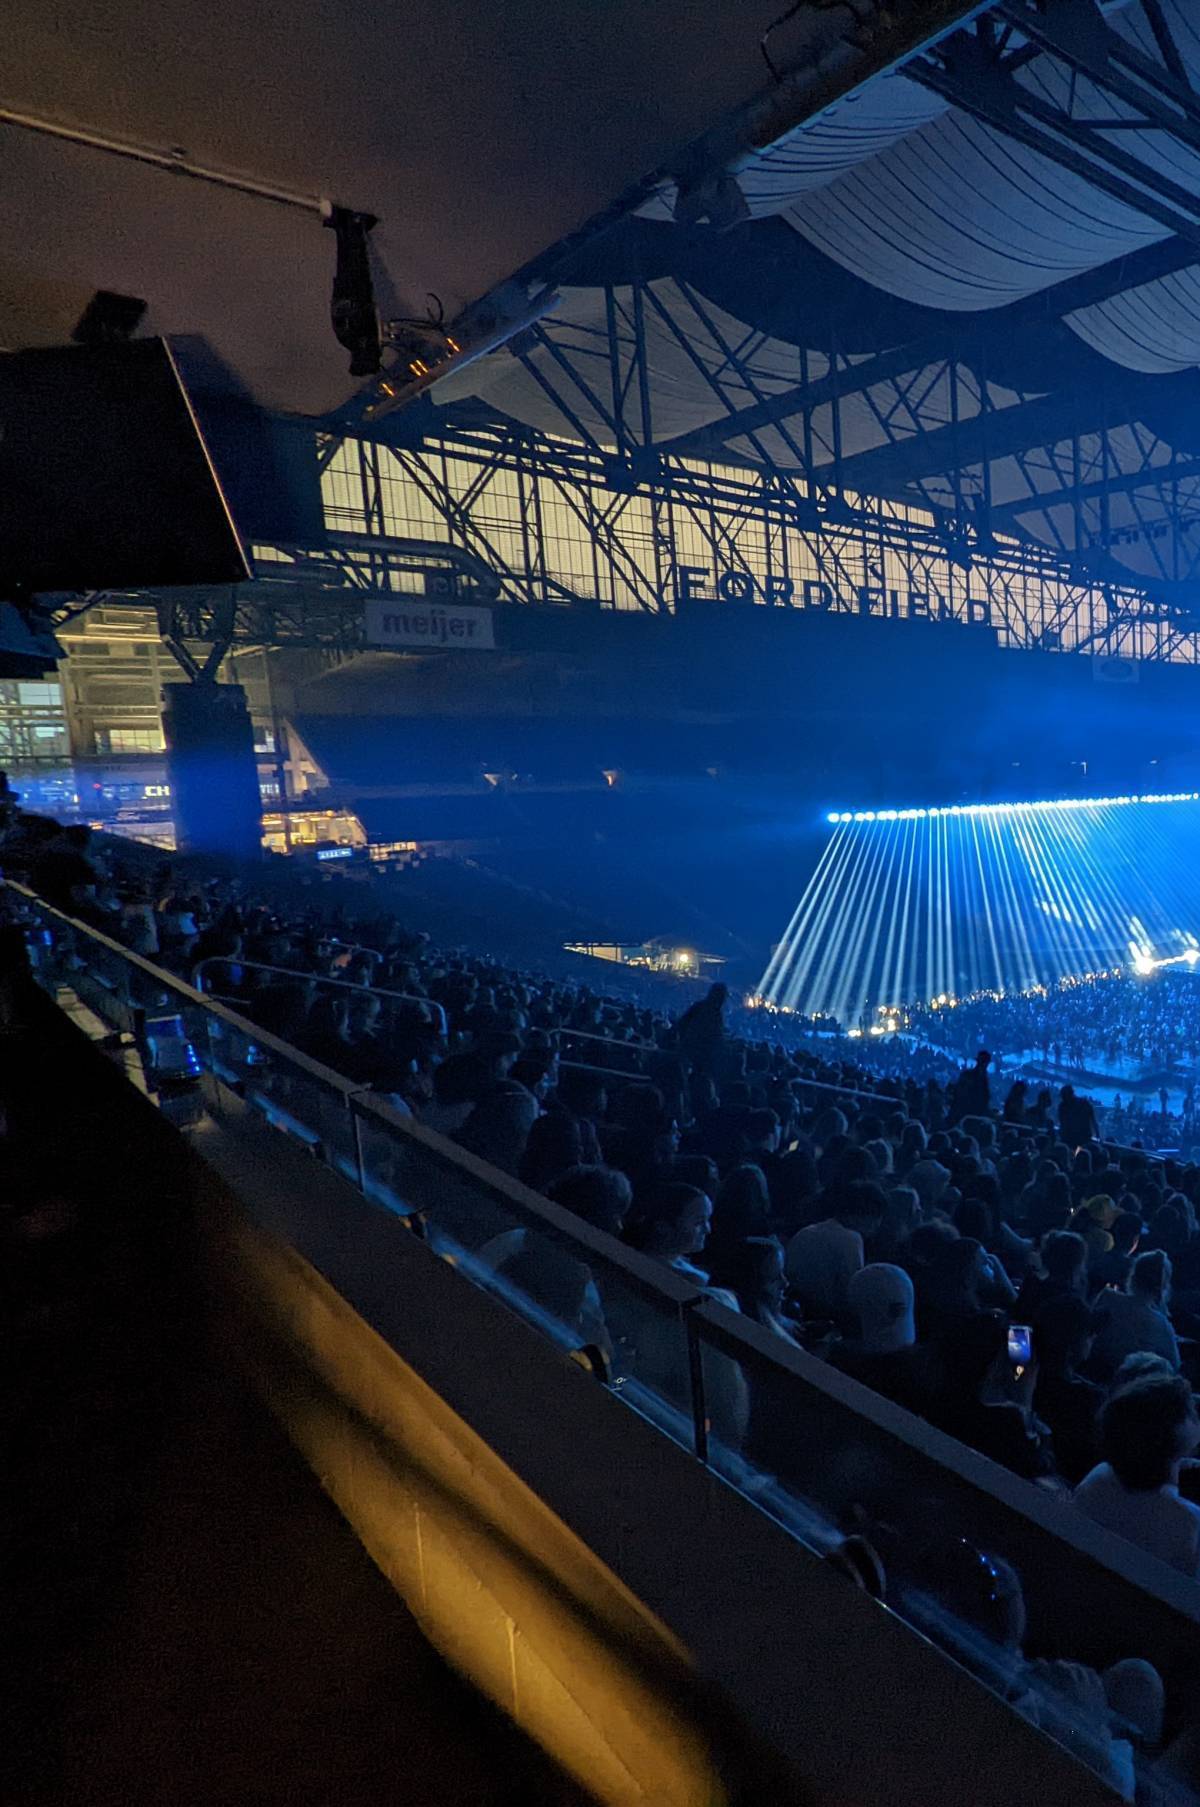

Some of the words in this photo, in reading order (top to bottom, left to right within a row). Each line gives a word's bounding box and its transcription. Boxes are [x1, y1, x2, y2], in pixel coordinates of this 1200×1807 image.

[679, 565, 833, 611] FORD
[858, 586, 991, 626] FIELD
[382, 609, 477, 642] meijer
